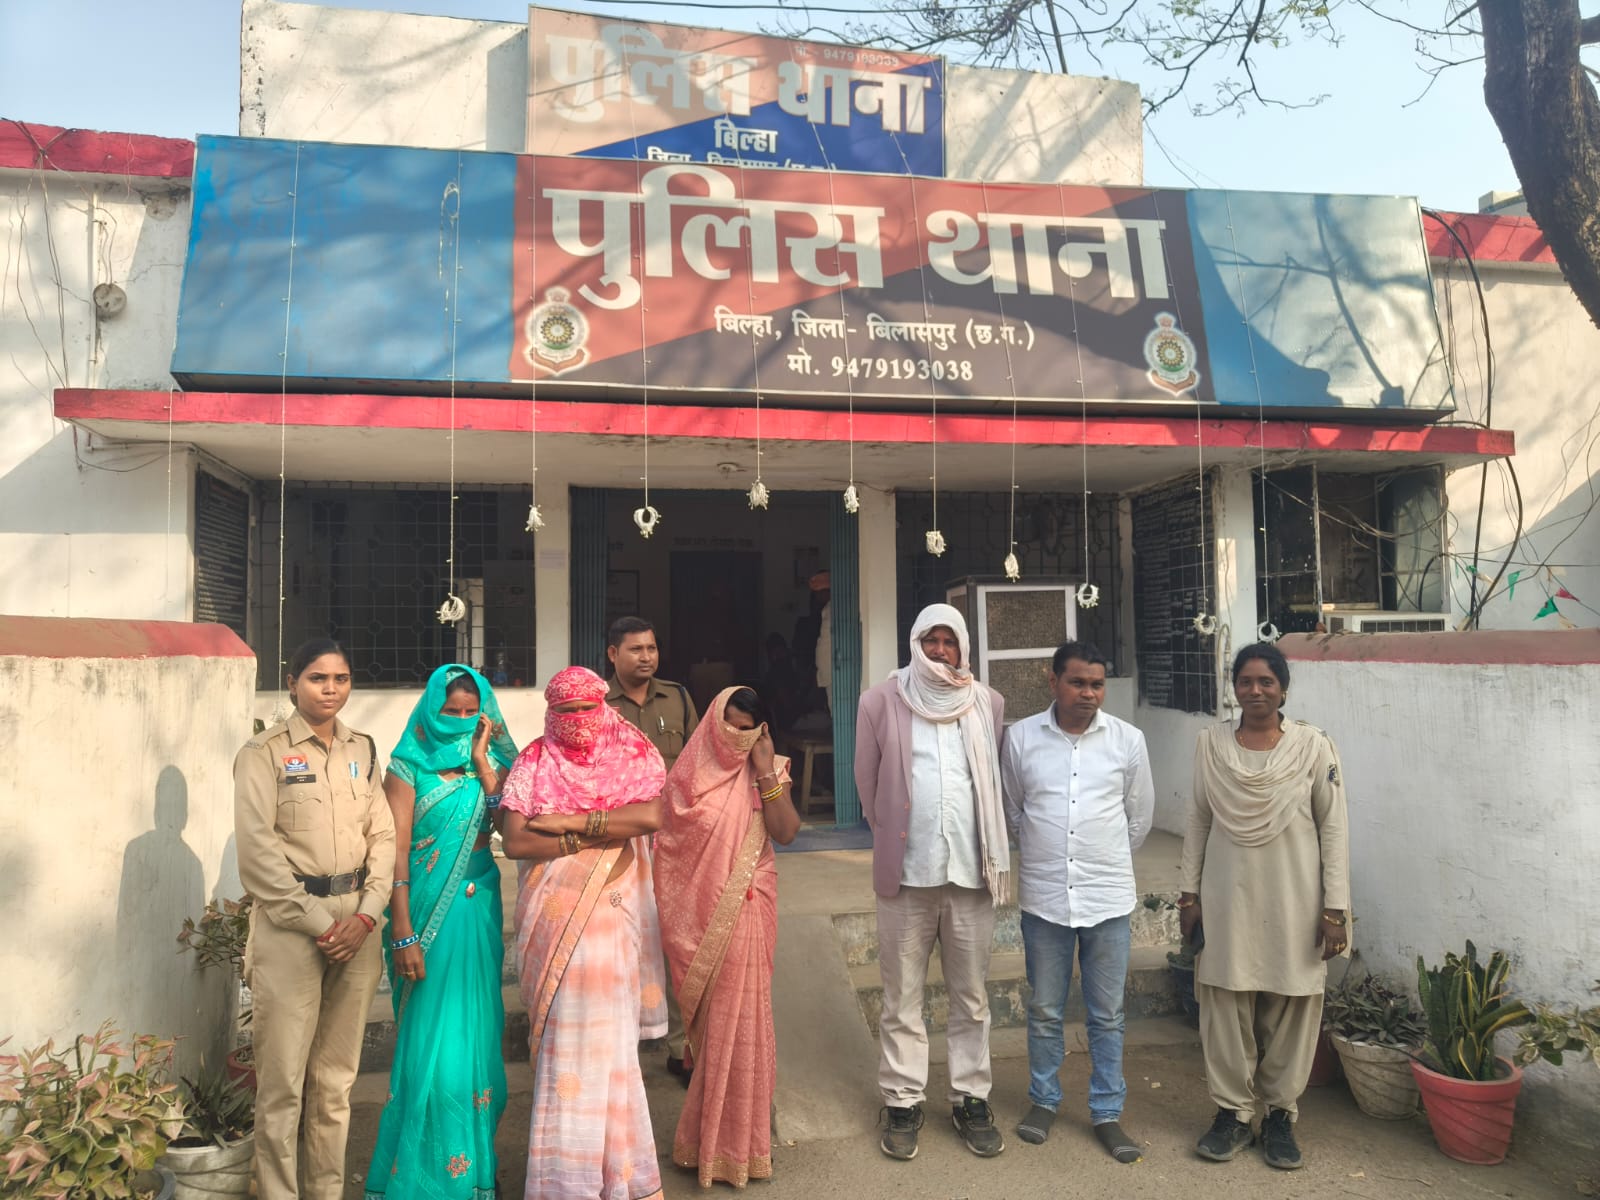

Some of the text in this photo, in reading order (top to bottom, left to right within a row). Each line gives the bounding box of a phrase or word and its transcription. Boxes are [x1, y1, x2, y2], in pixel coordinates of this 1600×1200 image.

[545, 24, 932, 134] पुलिस थाना
[713, 119, 778, 153] बिल्हा
[542, 164, 1166, 310] पुलिस थाना
[714, 304, 782, 341] बिल्हा,
[866, 313, 958, 351] बिलासपुर
[965, 318, 1035, 351] (छ.ग.)
[787, 347, 974, 381] मो. 9479193038
